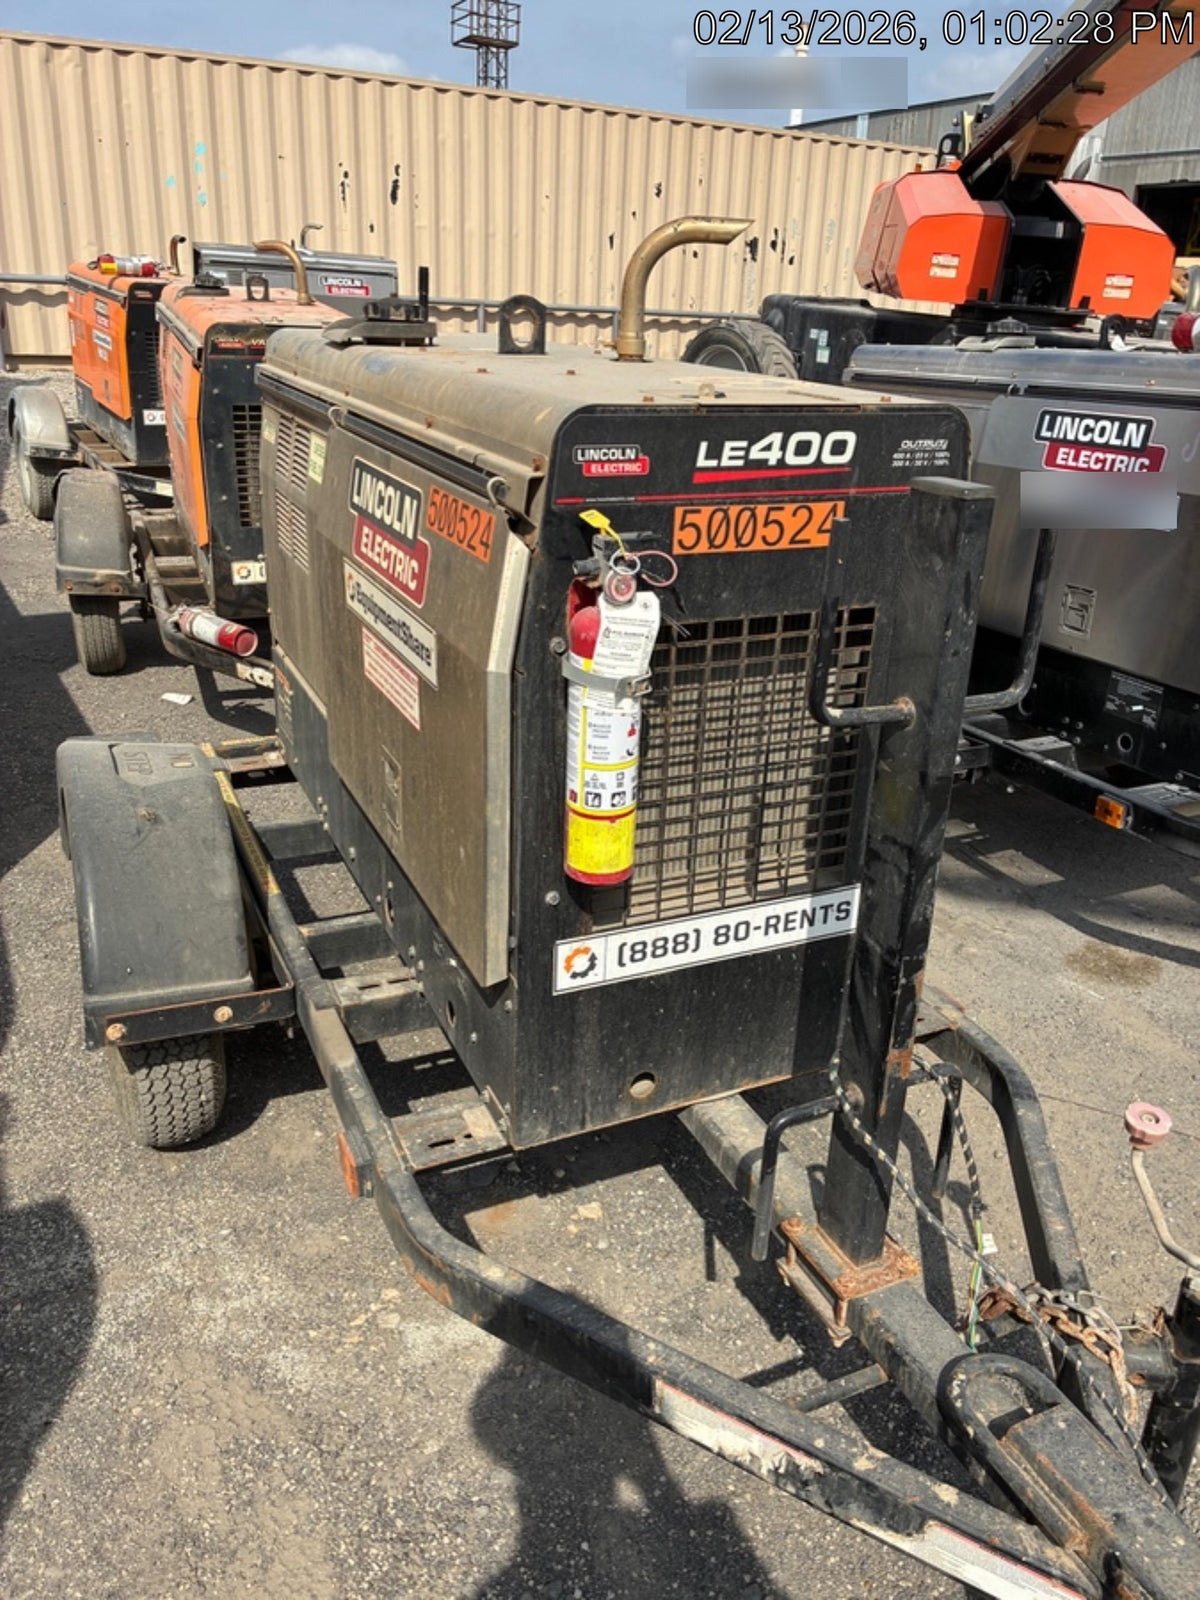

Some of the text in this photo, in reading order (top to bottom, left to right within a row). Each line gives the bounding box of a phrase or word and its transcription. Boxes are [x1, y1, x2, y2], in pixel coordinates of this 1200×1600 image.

[695, 430, 858, 468] LE400
[1040, 414, 1148, 449] LINCOLN
[577, 448, 636, 461] LINCOLN
[590, 462, 643, 474] ELECTRIC
[1055, 446, 1150, 472] ELECTRIC
[352, 467, 418, 540] LINCOLN
[427, 487, 492, 559] 500524
[677, 503, 839, 551] 500524
[360, 525, 419, 591] ELECTRIC
[616, 900, 852, 968] (888) 80-RENTS
